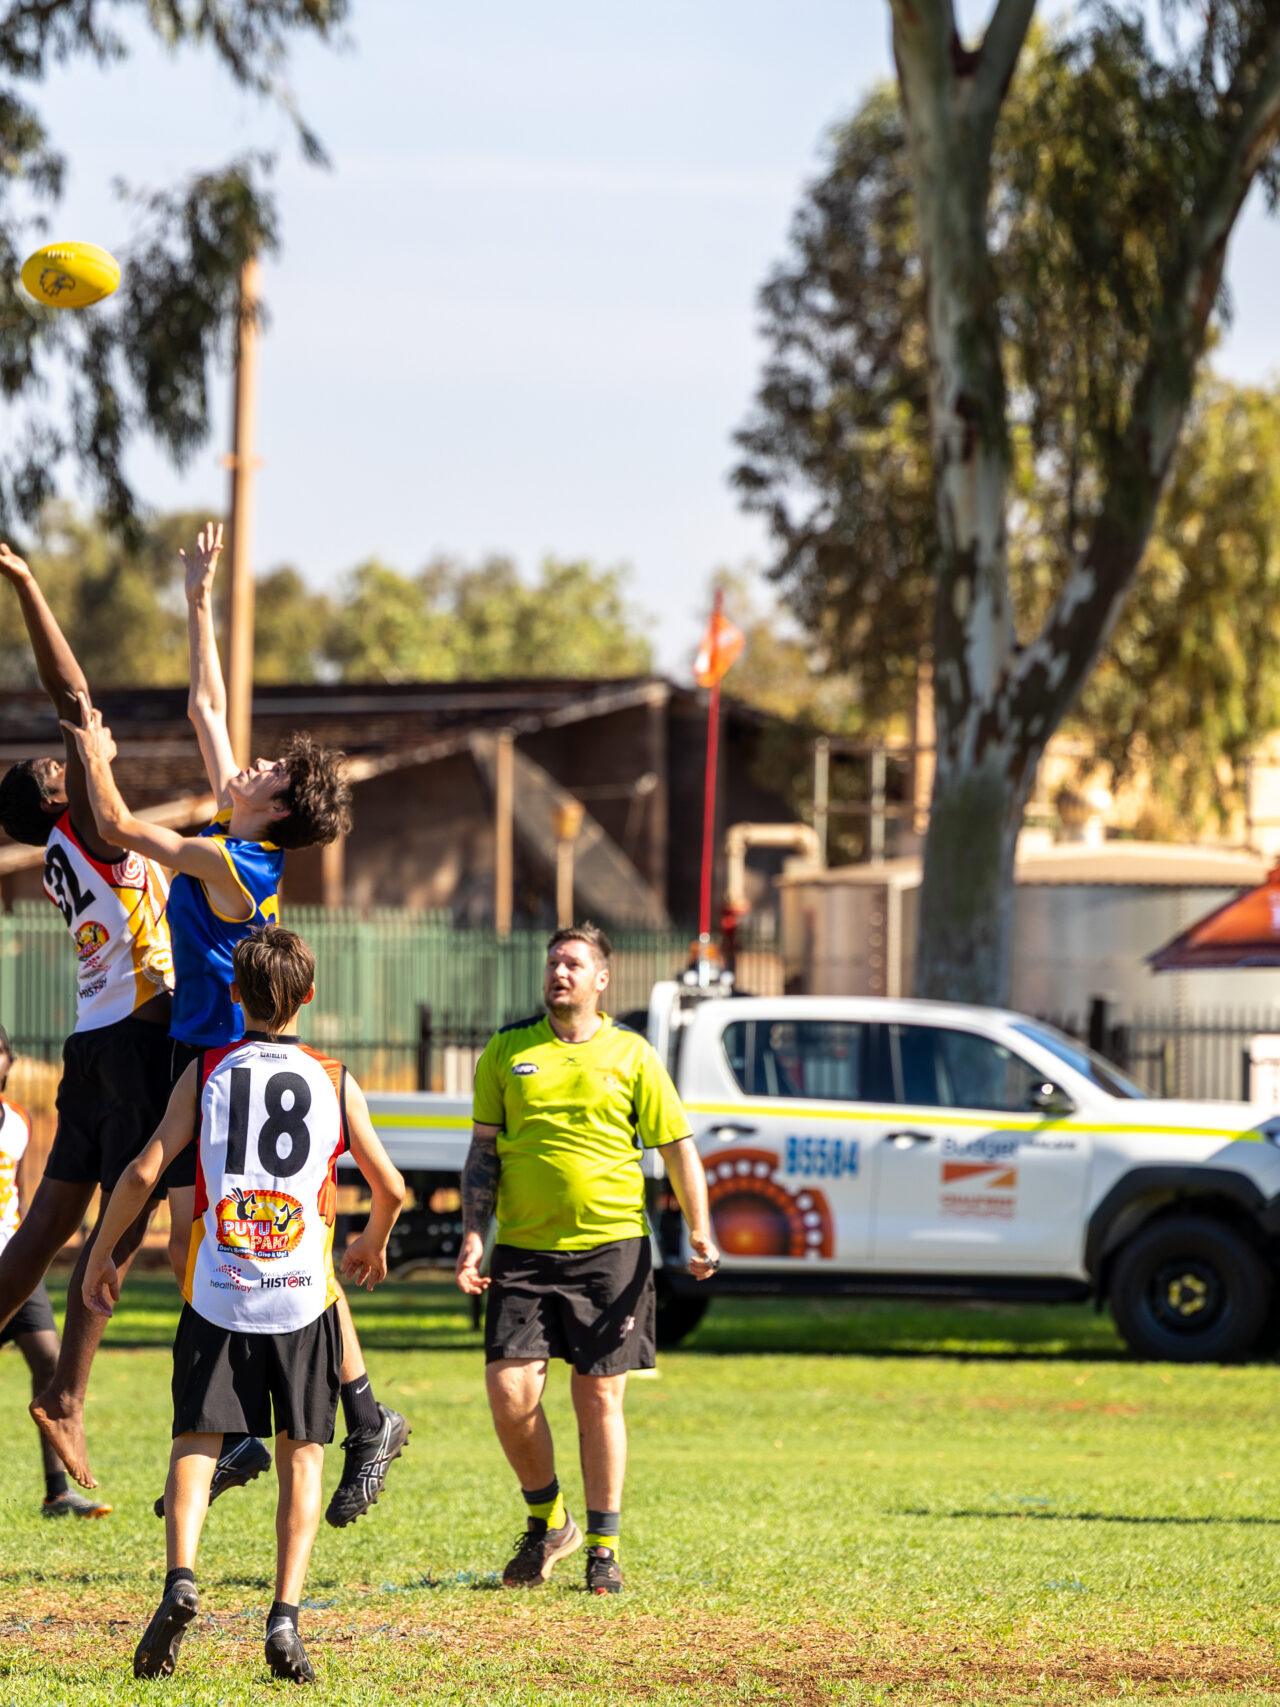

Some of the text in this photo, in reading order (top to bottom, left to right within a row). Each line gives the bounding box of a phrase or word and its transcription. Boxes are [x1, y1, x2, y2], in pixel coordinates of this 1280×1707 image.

[224, 1067, 312, 1179] 18
[941, 1137, 1019, 1162] Budget
[223, 1220, 271, 1236] PUYU
[257, 1250, 271, 1258] Give
[209, 1279, 253, 1293] healthway
